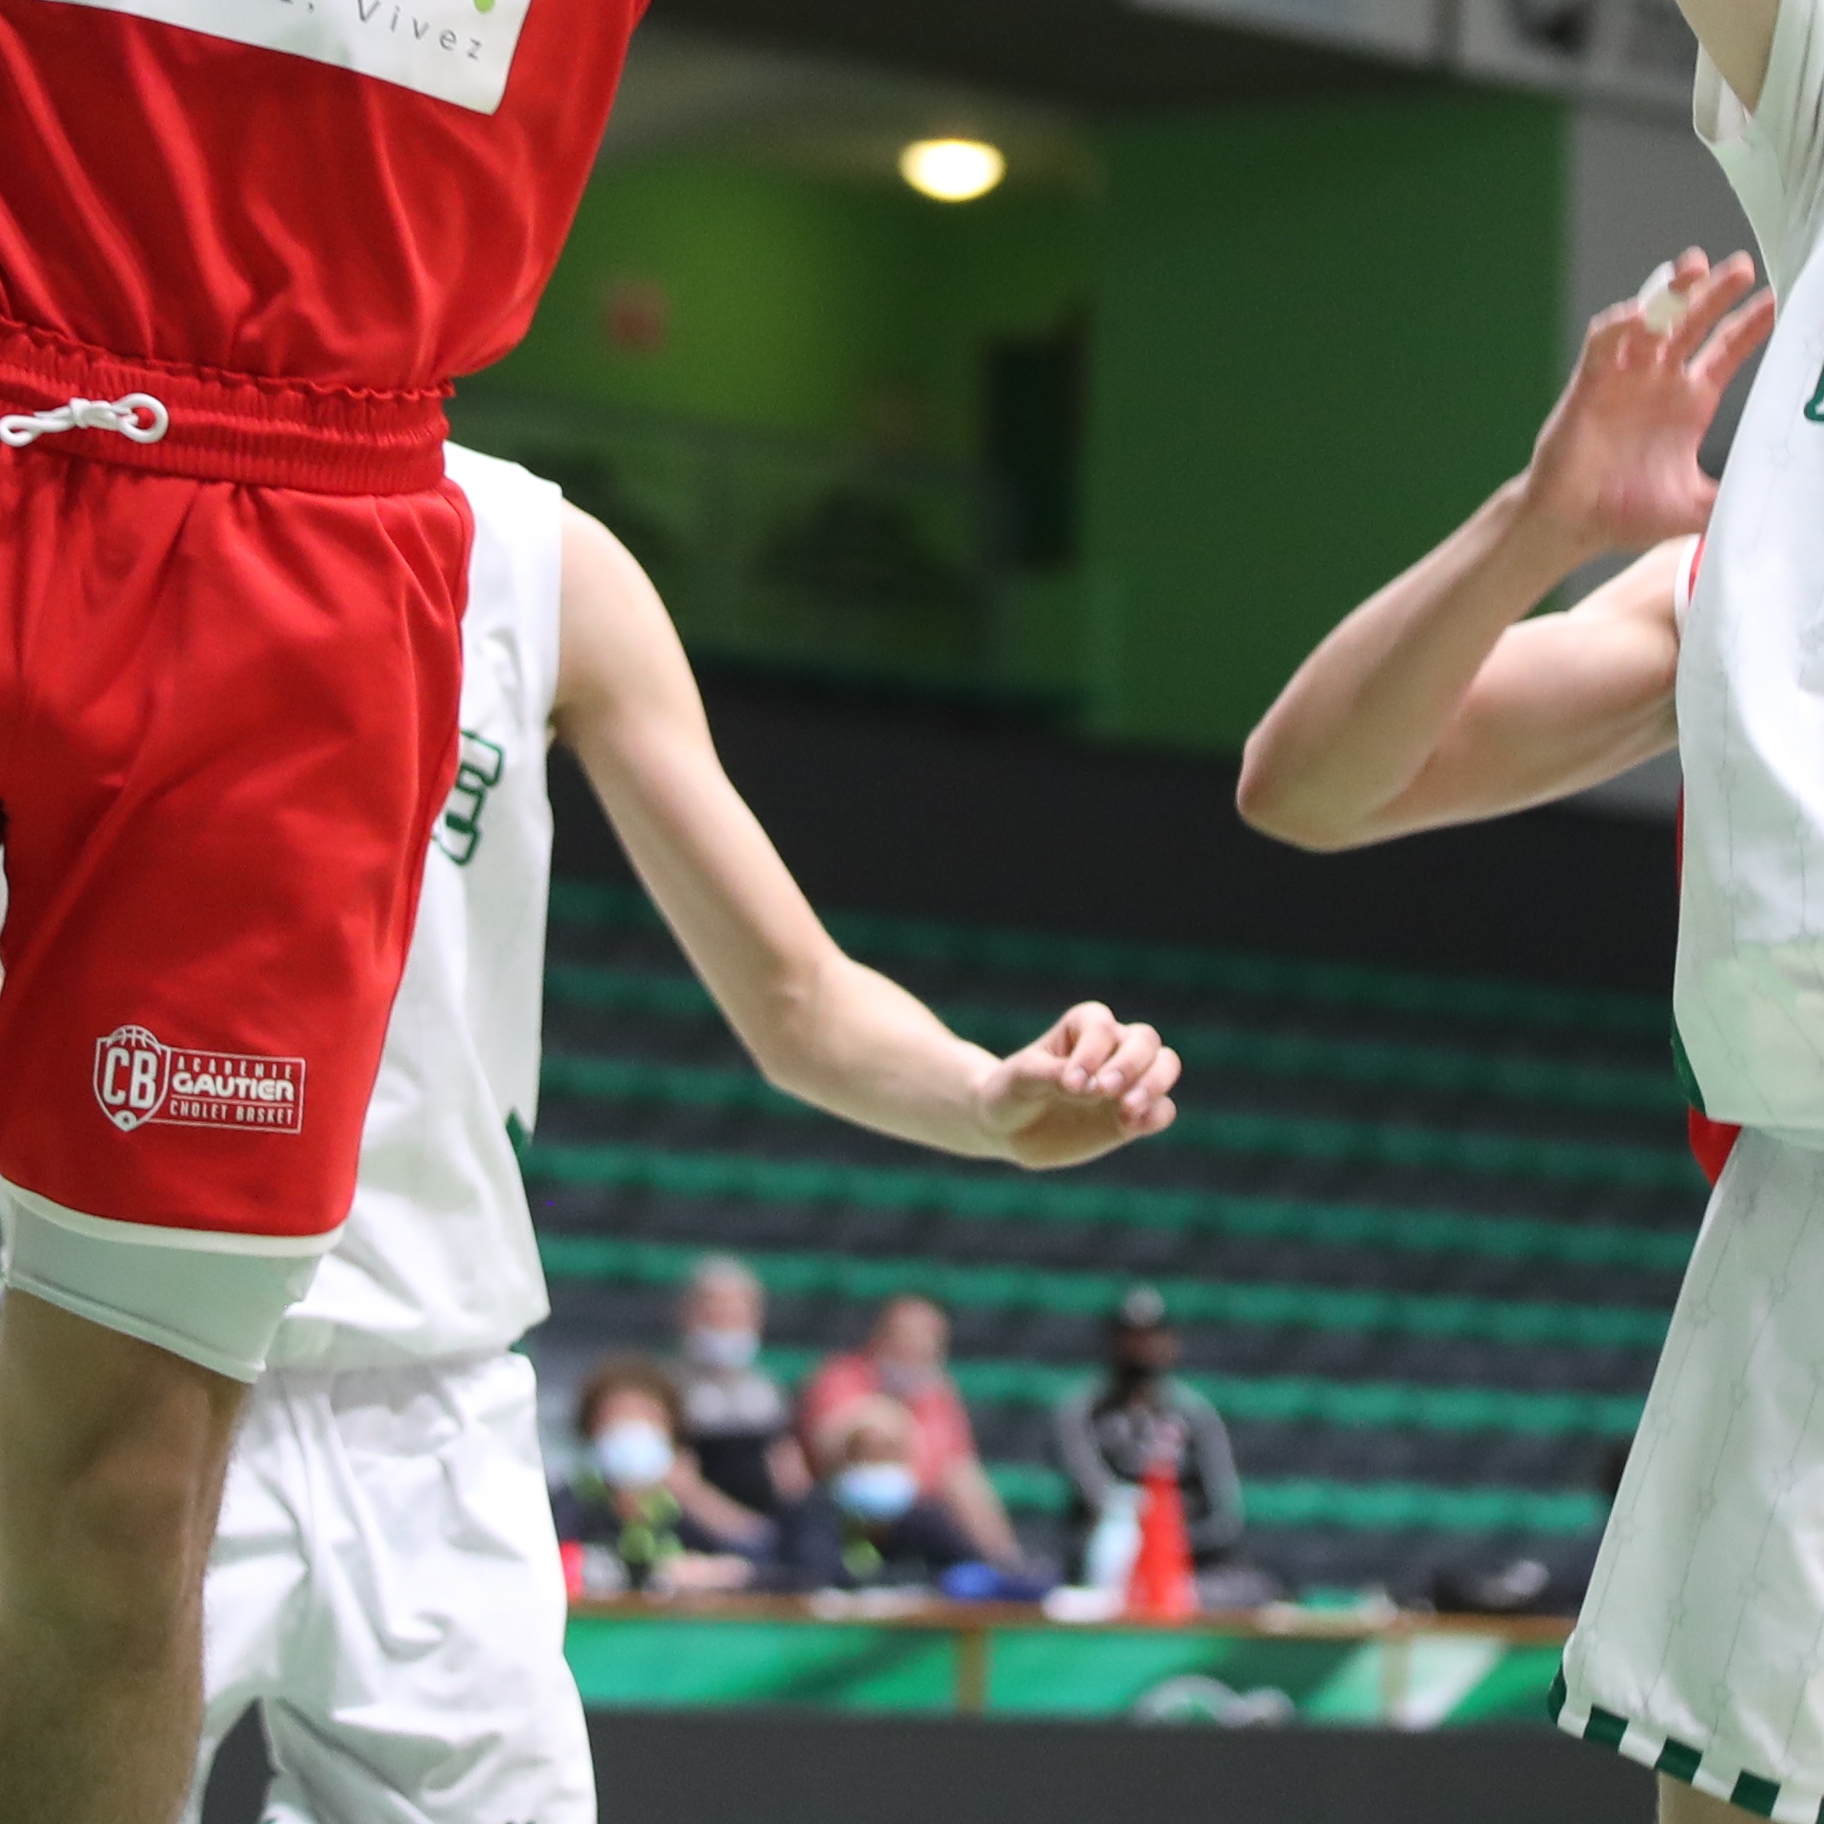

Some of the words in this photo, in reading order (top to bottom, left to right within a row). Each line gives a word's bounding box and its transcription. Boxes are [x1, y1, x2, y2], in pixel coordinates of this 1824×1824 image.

[102, 1046, 159, 1110] CB
[171, 1071, 295, 1102] GAUTIER
[169, 1099, 229, 1120] CHOLET
[235, 1105, 295, 1125] BASKET
